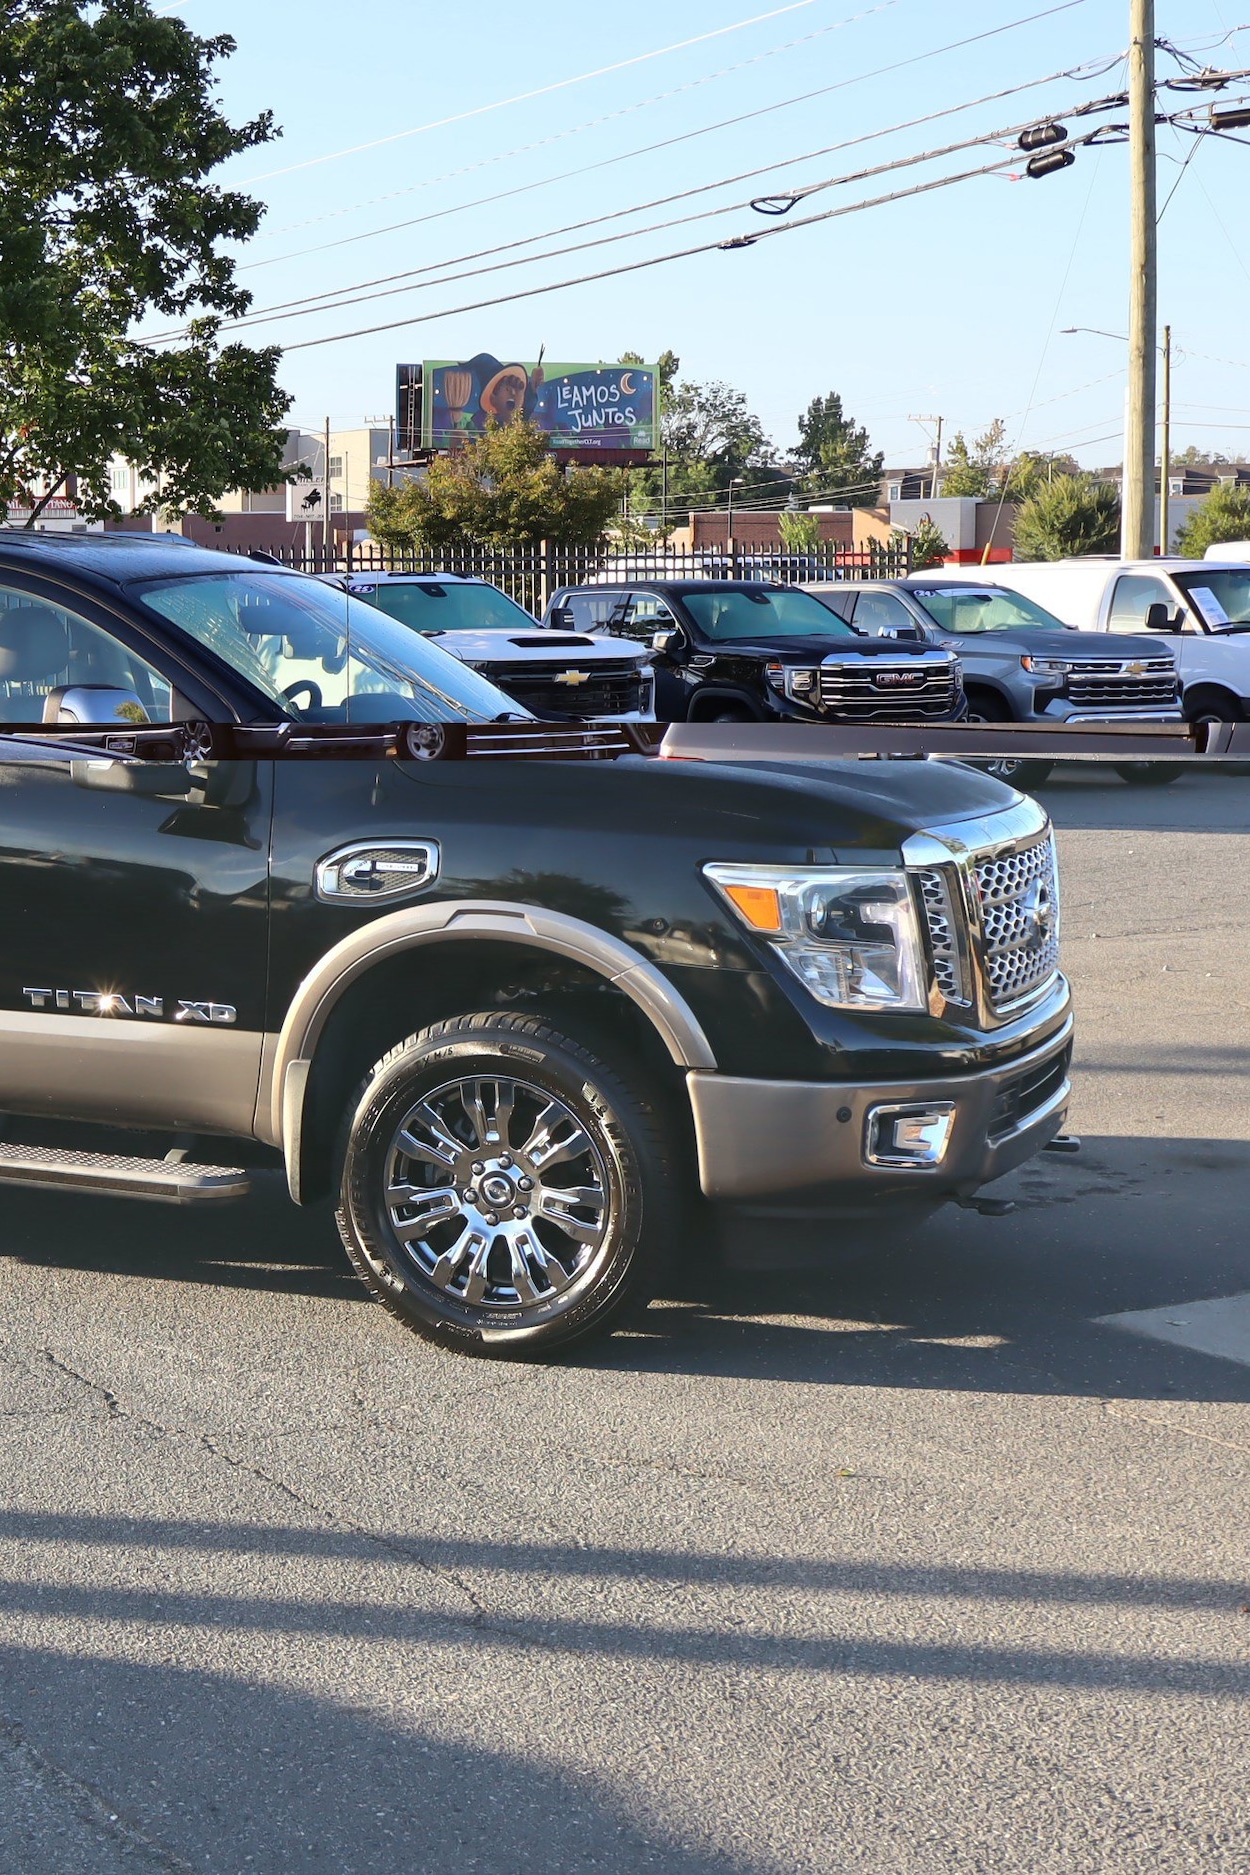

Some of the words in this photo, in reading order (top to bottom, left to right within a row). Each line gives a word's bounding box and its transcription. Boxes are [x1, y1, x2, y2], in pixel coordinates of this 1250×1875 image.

[557, 384, 620, 410] LEAMOS
[633, 436, 650, 445] Read
[876, 672, 924, 685] GMC
[22, 987, 164, 1017] TITAN
[175, 999, 238, 1023] XD
